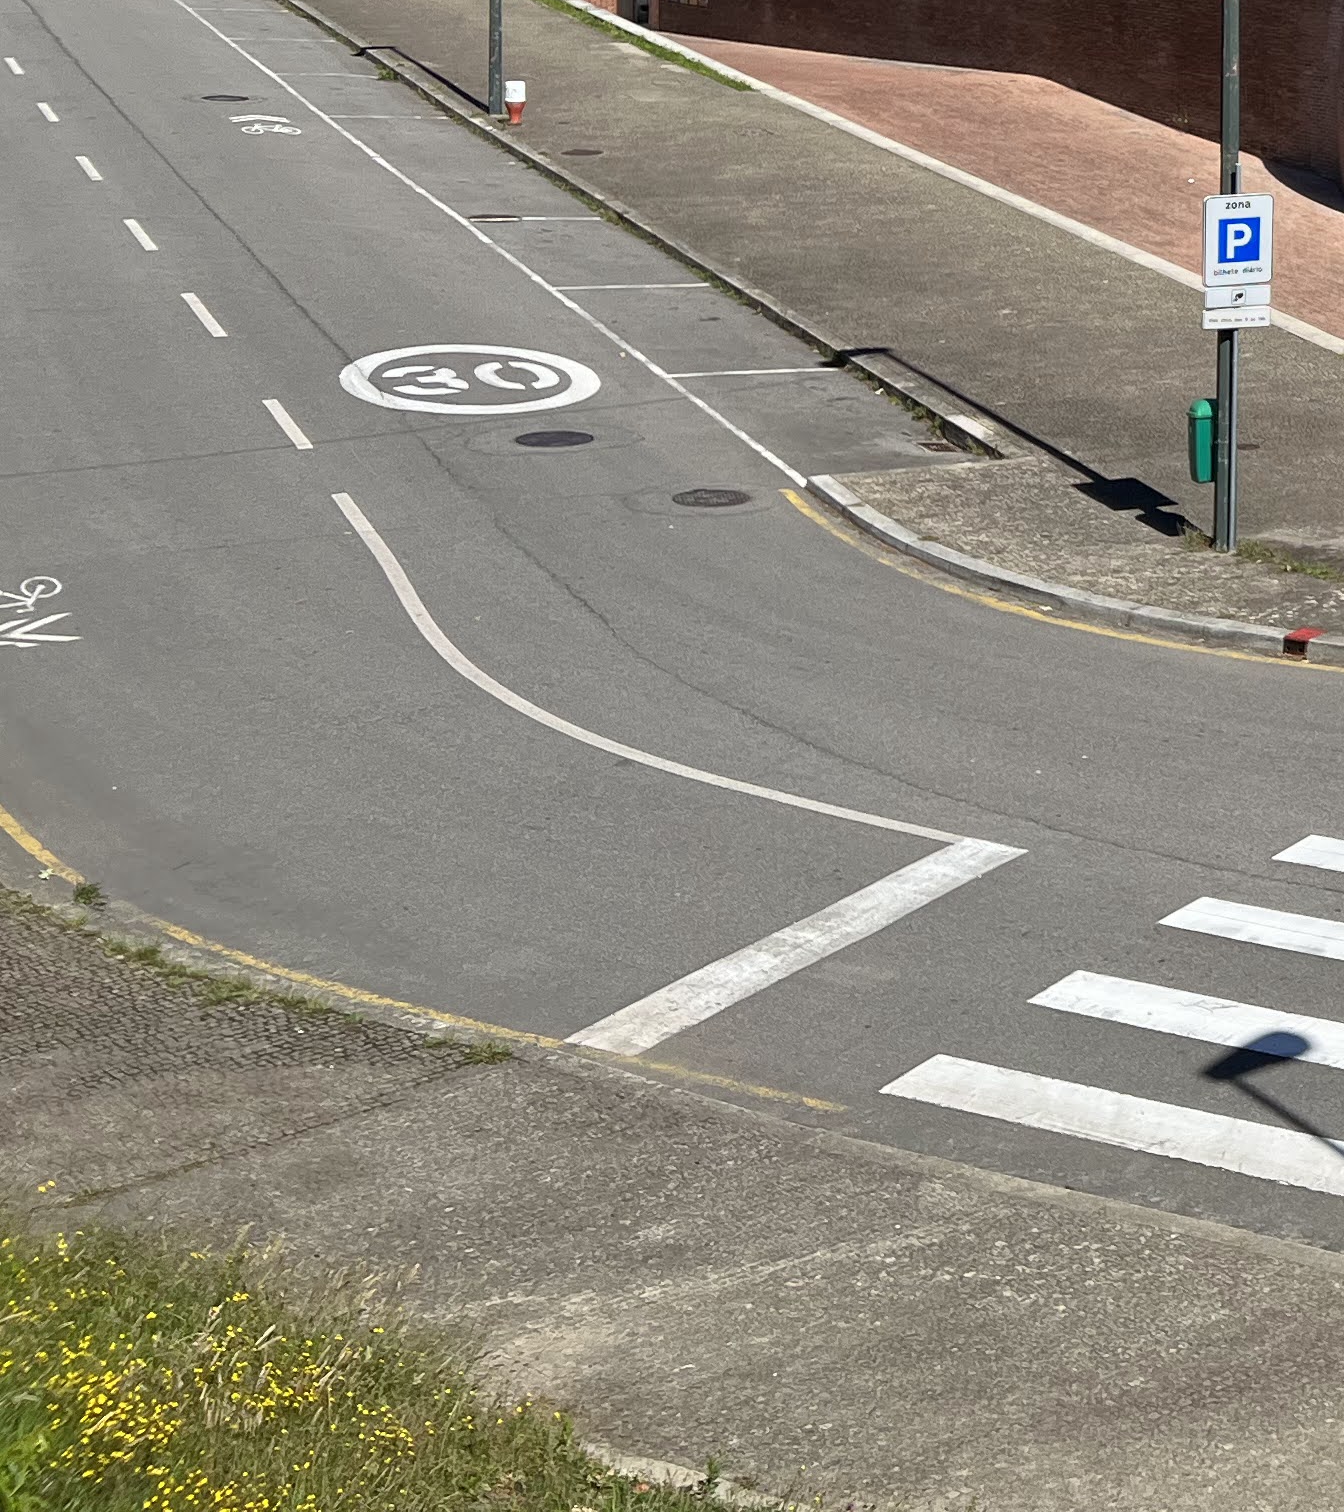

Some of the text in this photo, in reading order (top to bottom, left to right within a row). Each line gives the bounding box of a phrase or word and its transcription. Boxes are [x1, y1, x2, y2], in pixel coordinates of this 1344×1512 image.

[1225, 201, 1251, 210] zona
[1226, 223, 1252, 259] P
[382, 361, 559, 395] 30
